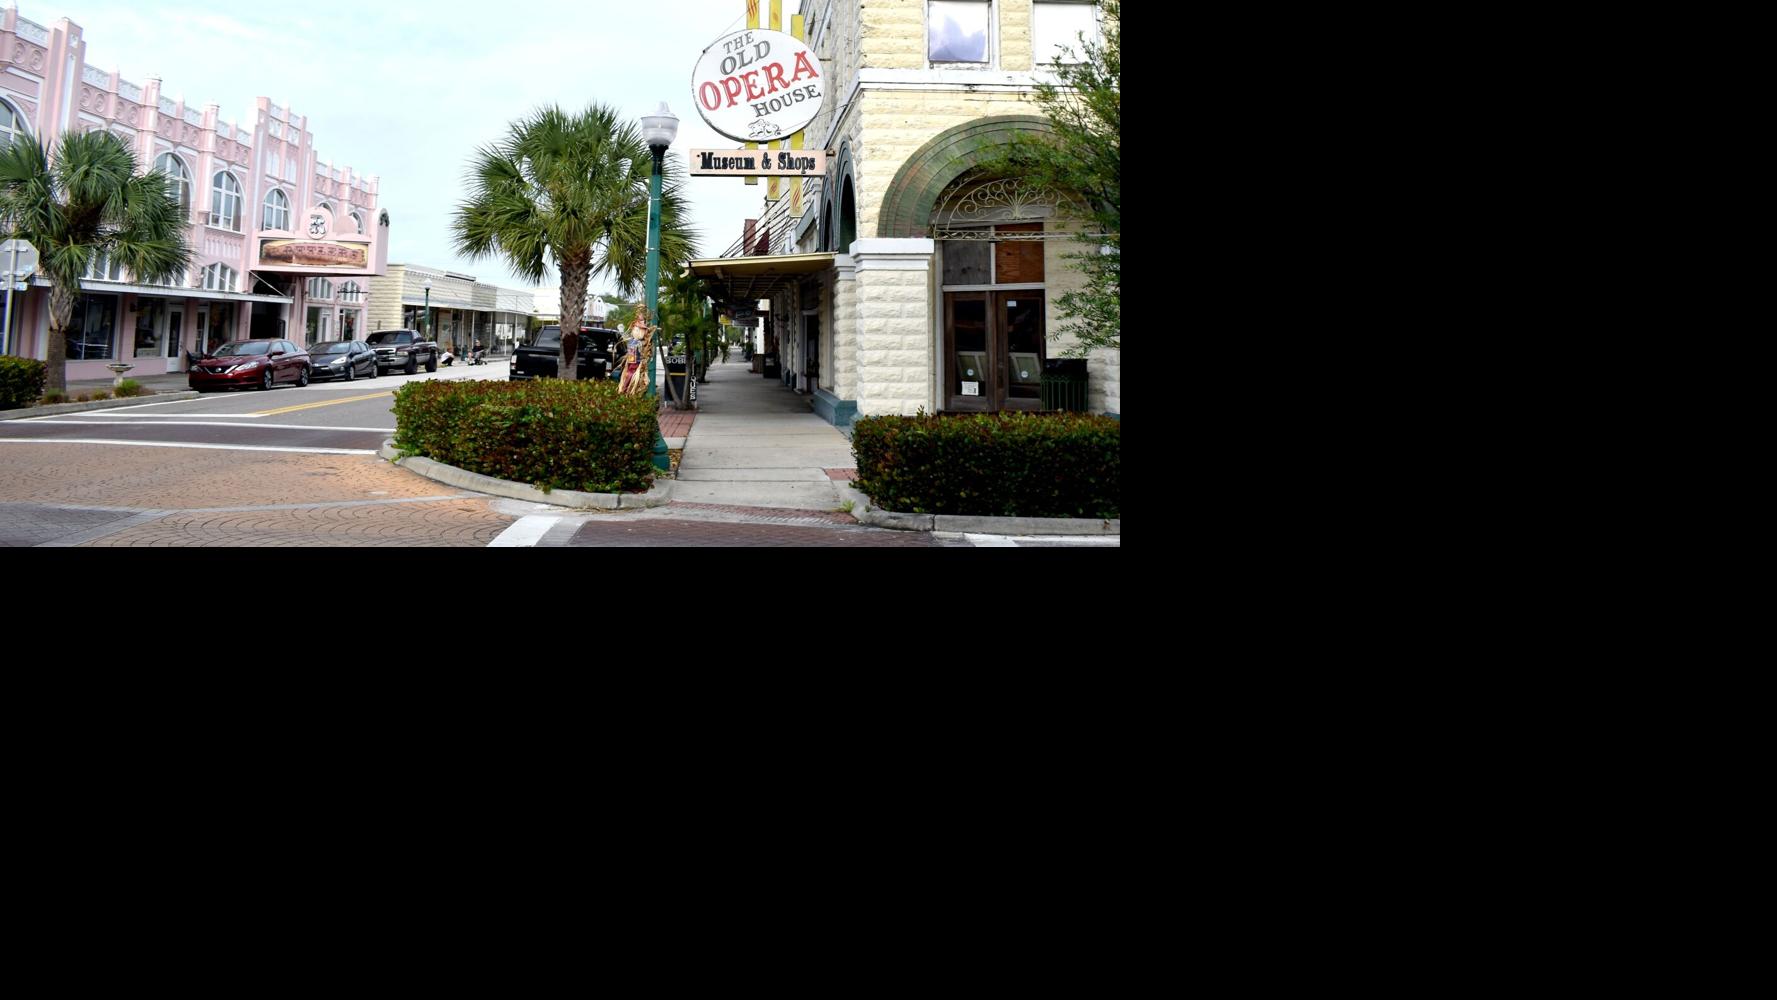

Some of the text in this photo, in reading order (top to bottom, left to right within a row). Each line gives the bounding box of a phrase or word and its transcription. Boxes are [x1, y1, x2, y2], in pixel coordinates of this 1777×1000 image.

[720, 40, 770, 75] OLD
[723, 31, 754, 54] THE
[699, 51, 819, 111] OPERA
[750, 84, 821, 118] HOUSE
[700, 152, 816, 174] Museum & Shops
